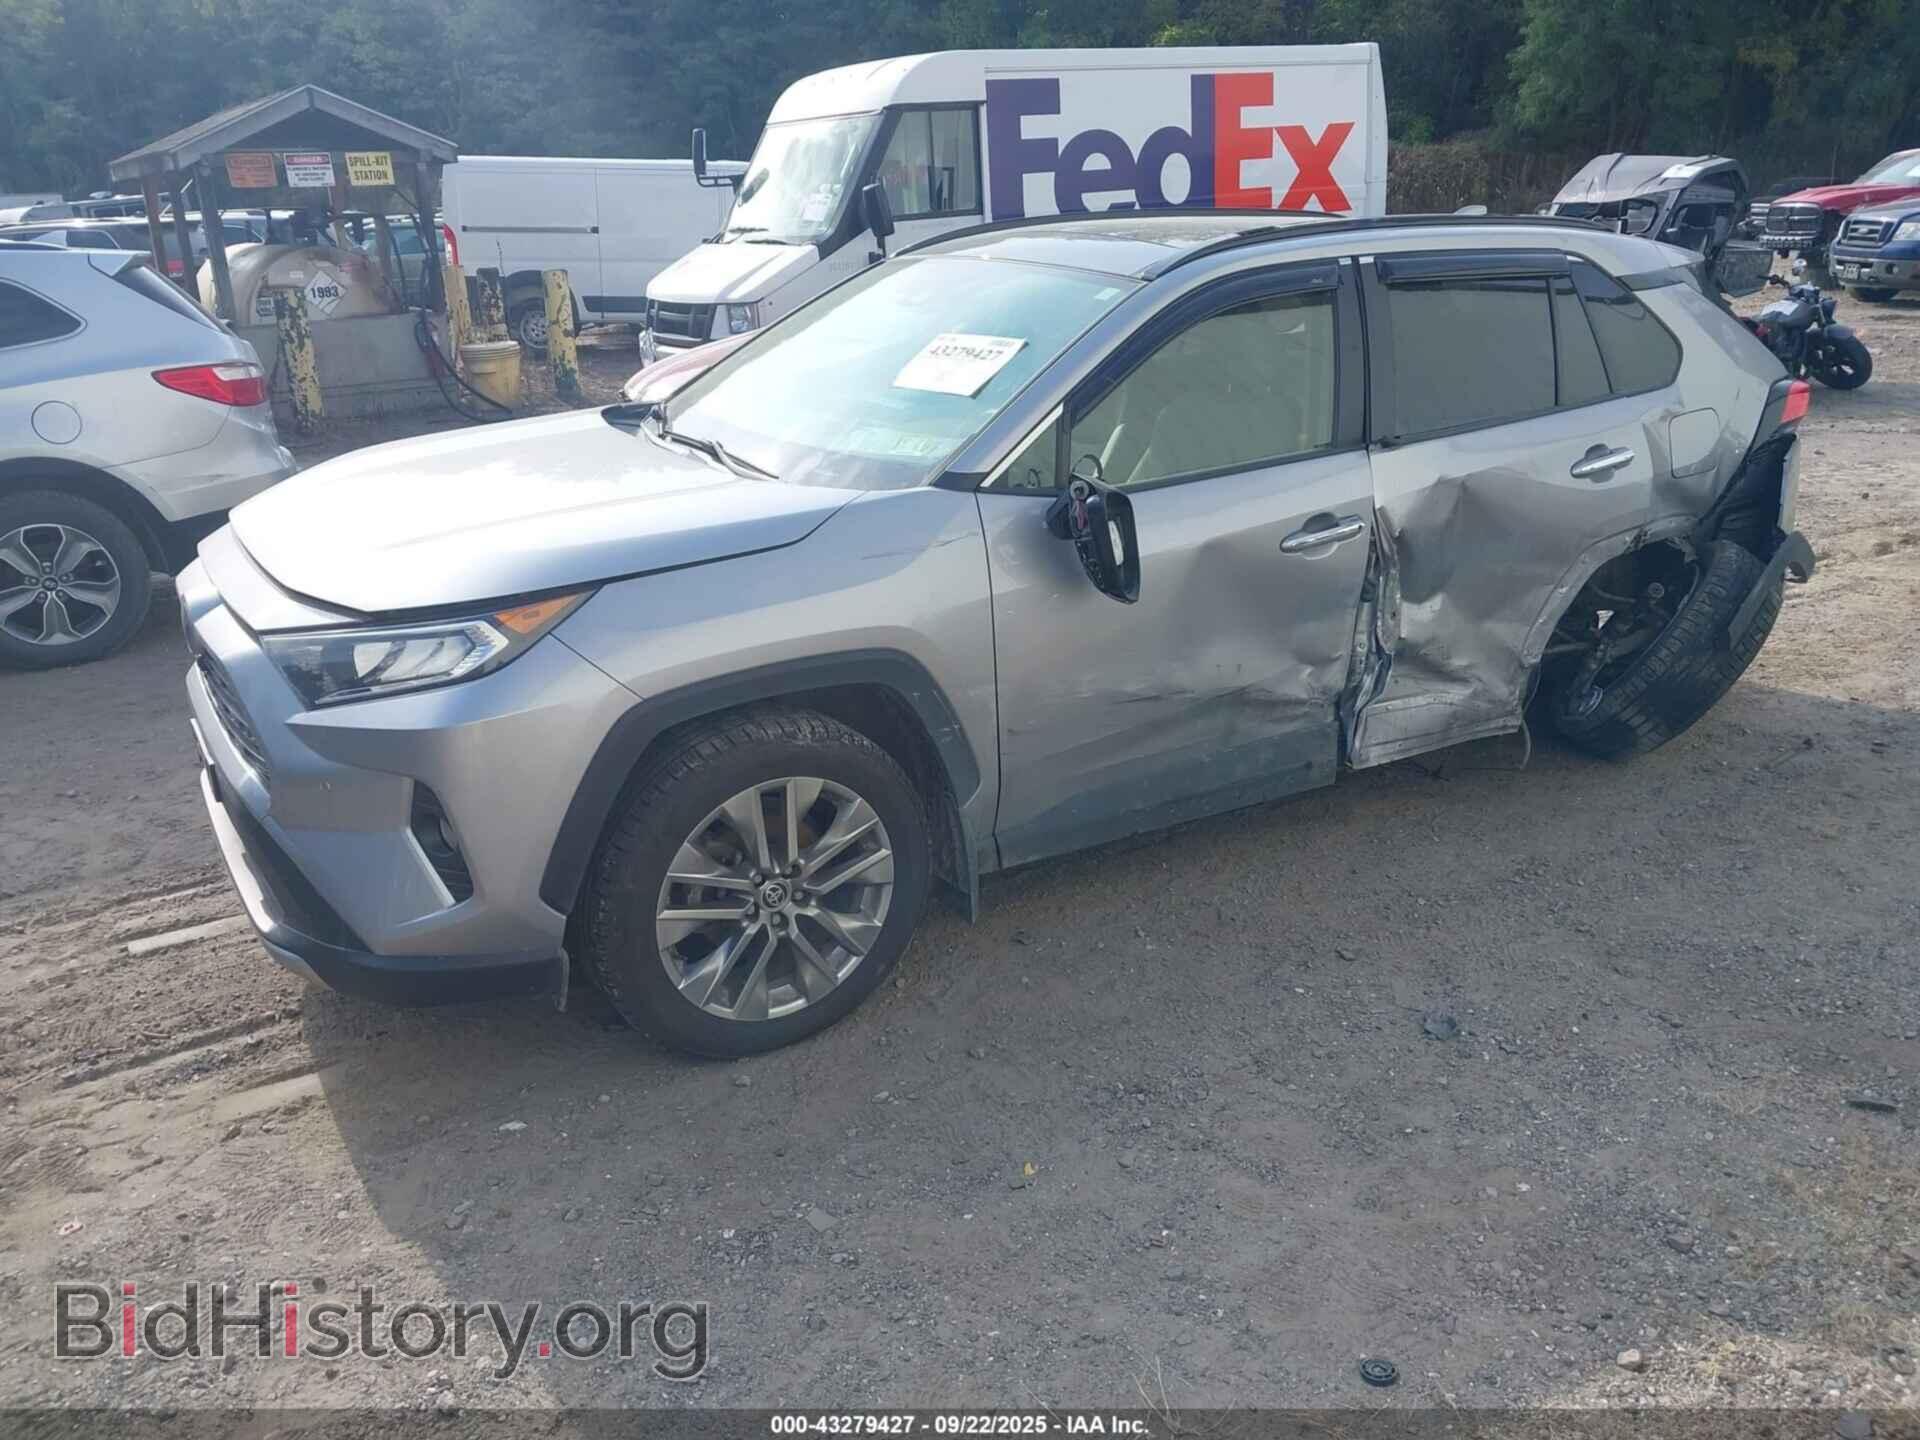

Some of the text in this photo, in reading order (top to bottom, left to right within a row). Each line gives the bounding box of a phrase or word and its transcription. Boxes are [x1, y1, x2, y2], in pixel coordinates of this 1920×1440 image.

[986, 72, 1355, 220] FedEx
[348, 155, 388, 166] SPILL-KIT
[354, 170, 388, 181] STATION
[311, 286, 338, 298] 1993
